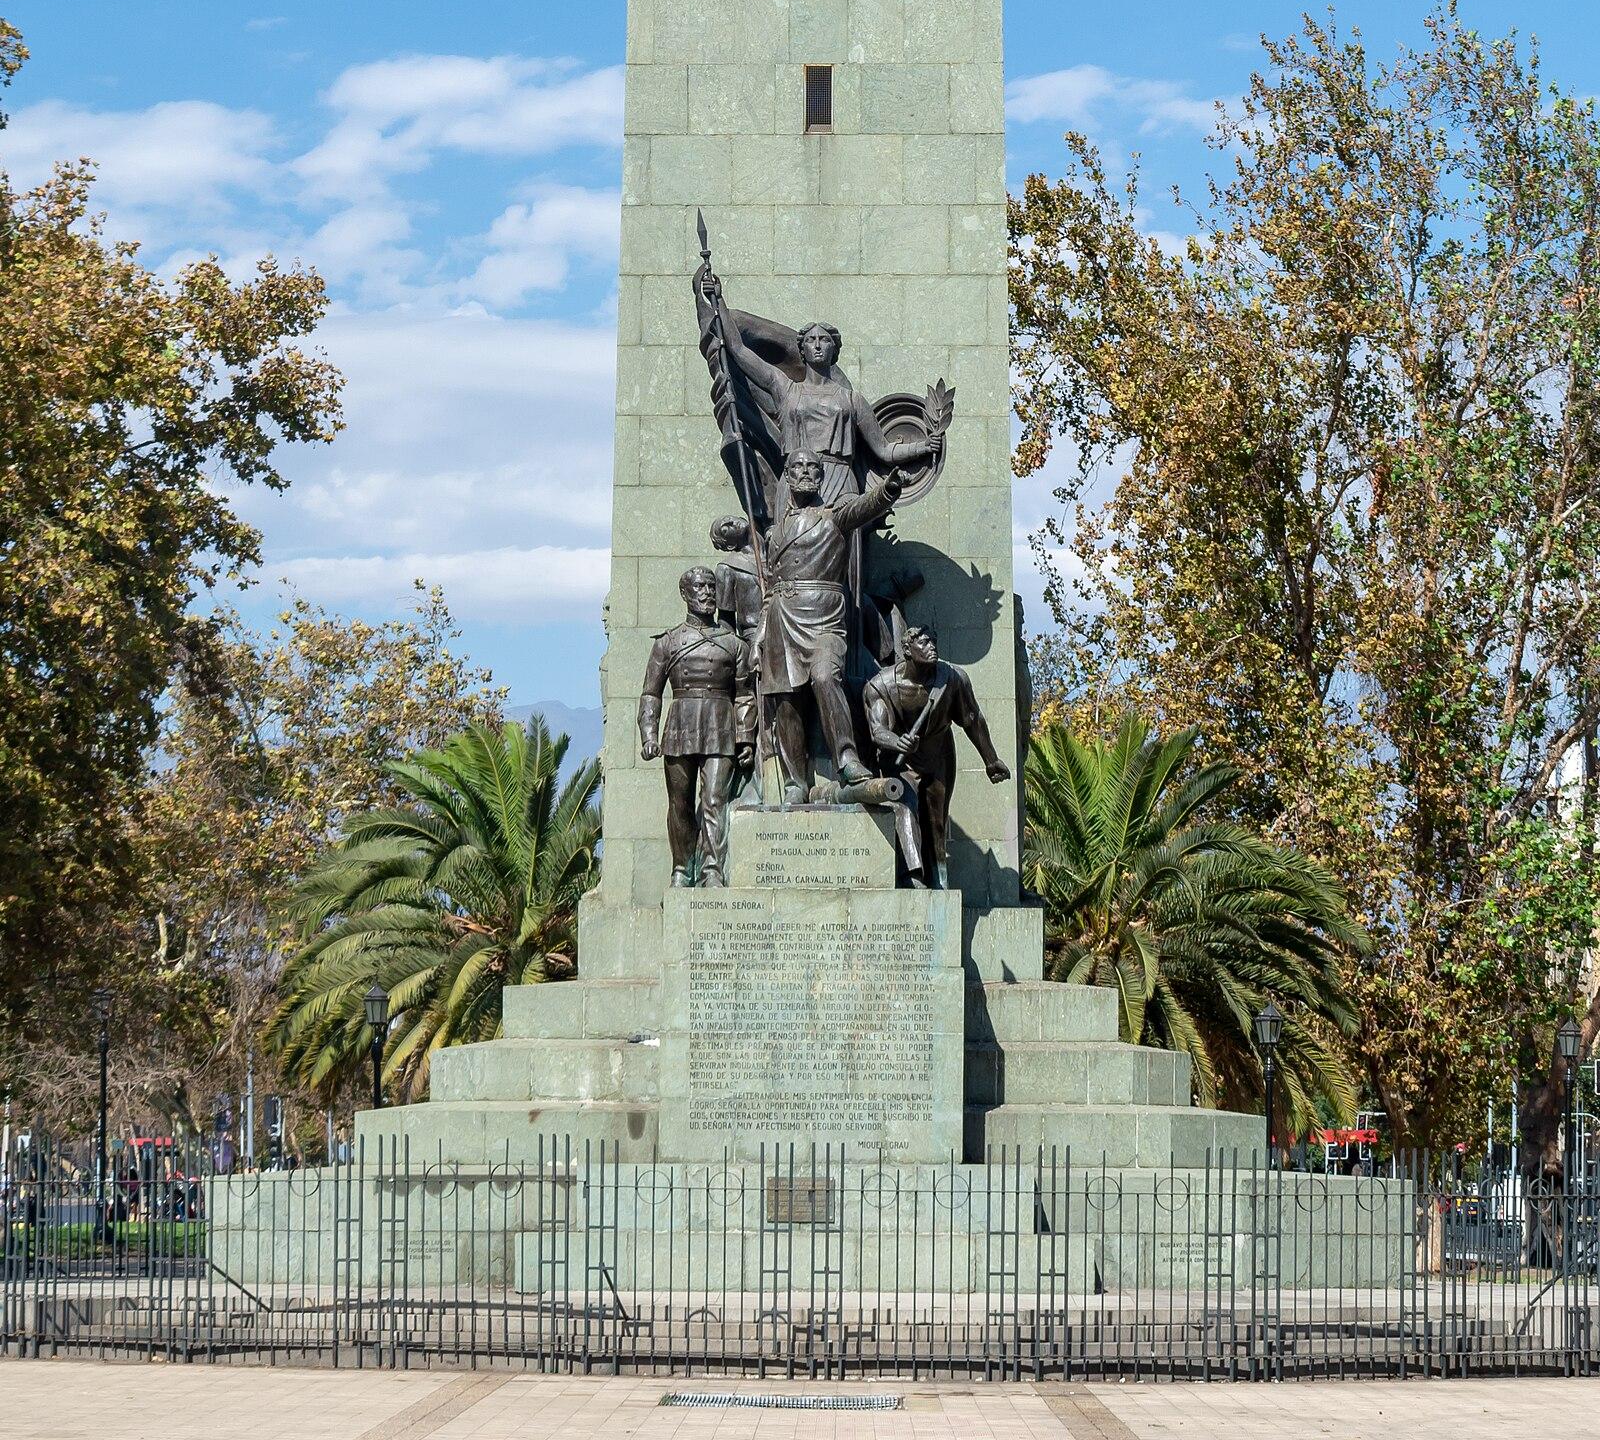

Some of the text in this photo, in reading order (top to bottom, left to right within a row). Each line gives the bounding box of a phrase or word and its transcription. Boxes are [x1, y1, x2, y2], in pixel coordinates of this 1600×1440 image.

[756, 832, 789, 841] MONITOR
[805, 848, 828, 856] JUNIO
[831, 848, 835, 856] 2
[839, 848, 849, 856] DE
[756, 862, 785, 871] SEÑORA
[756, 875, 869, 884] CARMELA CARVAJAL DE PRAT
[736, 923, 772, 931] SAGRADO
[776, 923, 801, 931] DEBER
[805, 923, 816, 931] ME
[820, 923, 858, 931] AUTORIZA
[871, 923, 911, 931] DIRIGIRME
[699, 933, 934, 941] SIENTO PROFUNDAMENTE ESTA CARTA POR LAS LUCHAS
[690, 943, 705, 951] QUE
[708, 943, 717, 951] VA
[730, 943, 776, 951] REMEMORAR
[779, 943, 824, 951] CONTRIBUYA
[919, 943, 934, 951] QUE
[690, 953, 932, 961] HOY JUSTAMENTE EN NAVAL DEL
[700, 963, 734, 971] PROXIMO
[771, 963, 786, 971] QUE
[842, 963, 852, 971] EN
[902, 963, 913, 971] DE
[708, 973, 733, 981] ENTRE
[874, 973, 884, 981] SU
[887, 973, 910, 981] DIGNO
[690, 983, 719, 991] LEROSO
[770, 983, 803, 991] CAPITAN
[860, 983, 876, 991] DON
[879, 983, 910, 991] ARTURO
[837, 993, 860, 1001] COMO
[875, 993, 886, 1001] NO
[690, 1003, 700, 1011] RA
[703, 1003, 713, 1011] YA
[716, 1003, 746, 1011] VICTIMA
[749, 1003, 759, 1011] DE
[762, 1003, 773, 1011] SU
[690, 1013, 701, 1021] RIA
[705, 1013, 714, 1021] DE
[768, 1013, 778, 1021] DE
[781, 1013, 793, 1021] SU
[795, 1013, 820, 1021] PATRIA
[876, 1013, 934, 1021] SINCERAMENTE
[707, 1022, 743, 1031] INFAUSTO
[746, 1022, 810, 1031] ACONTECIMIENTO
[820, 1021, 883, 1031] ACOMPAÑANDOLA
[887, 1022, 897, 1031] EN
[900, 1022, 910, 1031] SU
[690, 1043, 934, 1051] INESTIMABLES QUE SE ENCONTRARON EN PODER
[806, 1053, 816, 1061] EN
[819, 1053, 828, 1061] LA
[896, 1053, 920, 1061] ELLAS
[923, 1053, 933, 1061] LE
[690, 1061, 919, 1071] SERVIRAN ALGUN PEQUEÑO CONSUELO
[690, 1072, 713, 1080] MEDIO
[716, 1072, 726, 1080] DE
[730, 1072, 741, 1080] SU
[743, 1072, 785, 1080] DESGRACIA
[797, 1072, 813, 1080] POR
[834, 1072, 845, 1080] ME
[849, 1072, 860, 1080] HE
[863, 1072, 907, 1080] ANTICIPADO
[792, 1092, 806, 1100] MIS
[810, 1092, 864, 1101] SENTIMIENTOS
[868, 1092, 878, 1101] DE
[751, 1102, 761, 1110] LA
[765, 1102, 817, 1110] OPORTUNIDAD
[820, 1102, 839, 1110] PARA
[843, 1102, 886, 1110] OFRECERLE
[889, 1102, 904, 1110] MIS
[710, 1112, 778, 1120] CONSIDERACIONES
[791, 1112, 825, 1120] RESPETO
[829, 1112, 845, 1120] CON
[848, 1112, 863, 1120] QUE
[868, 1112, 879, 1120] ME
[883, 1112, 919, 1120] SUSCRIBO
[923, 1112, 933, 1120] DE
[702, 1121, 732, 1130] SEÑORA
[736, 1122, 753, 1130] MUY
[756, 1122, 801, 1130] AFECTISIMO
[812, 1122, 842, 1130] SEGURO
[845, 1122, 883, 1130] SERVIDOR
[857, 1141, 909, 1149] MIGUEL GRAU
